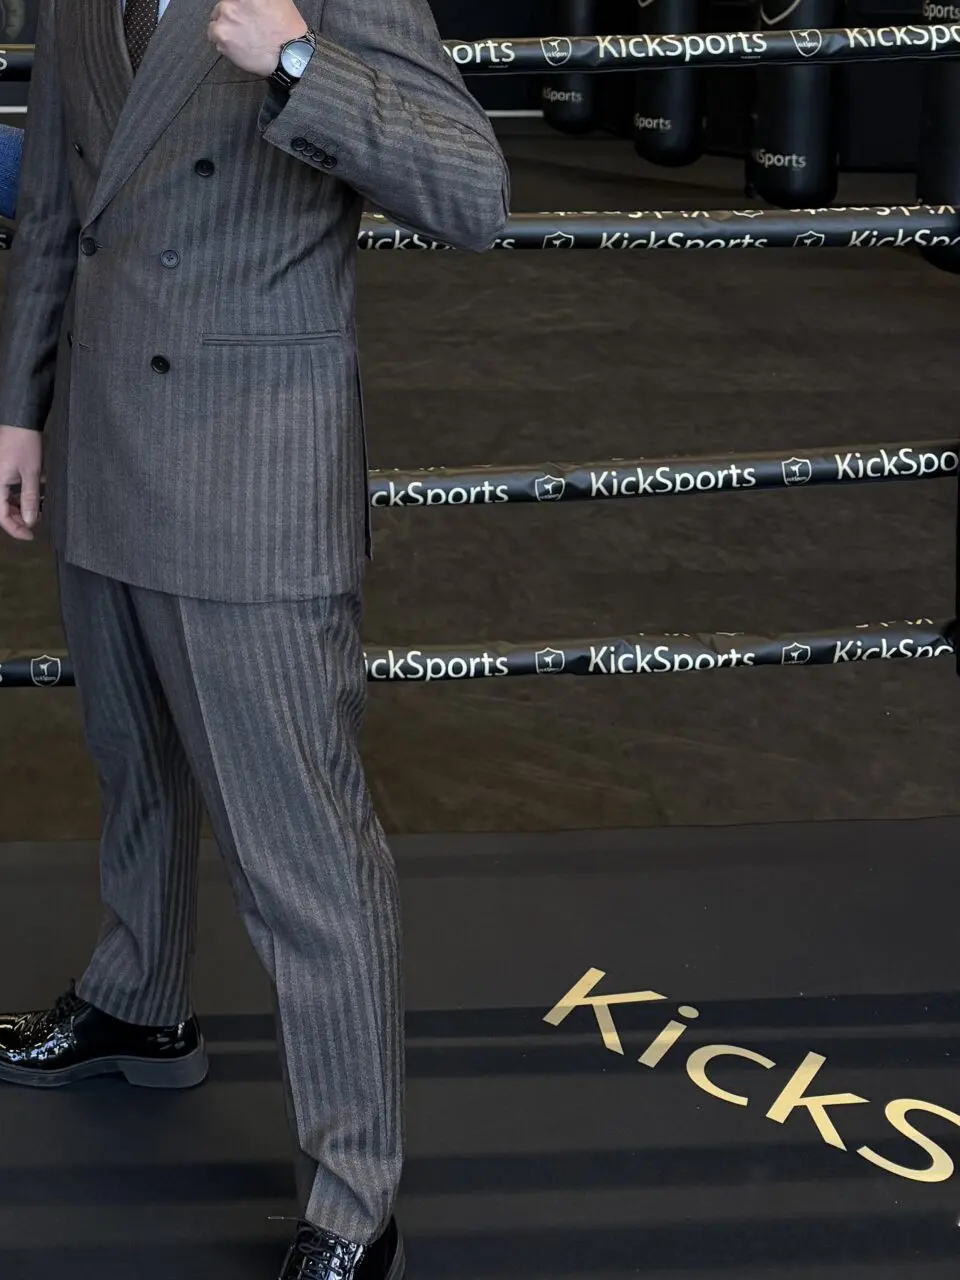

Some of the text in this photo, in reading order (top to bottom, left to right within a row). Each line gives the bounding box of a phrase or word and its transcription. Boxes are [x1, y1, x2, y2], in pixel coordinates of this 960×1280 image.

[443, 40, 515, 65] orts
[595, 32, 767, 62] KickSports
[754, 148, 807, 168] Sports
[591, 464, 756, 494] KickSports
[834, 448, 958, 479] KickSpo
[590, 644, 755, 673] KickSports
[542, 967, 960, 1183] KickS
